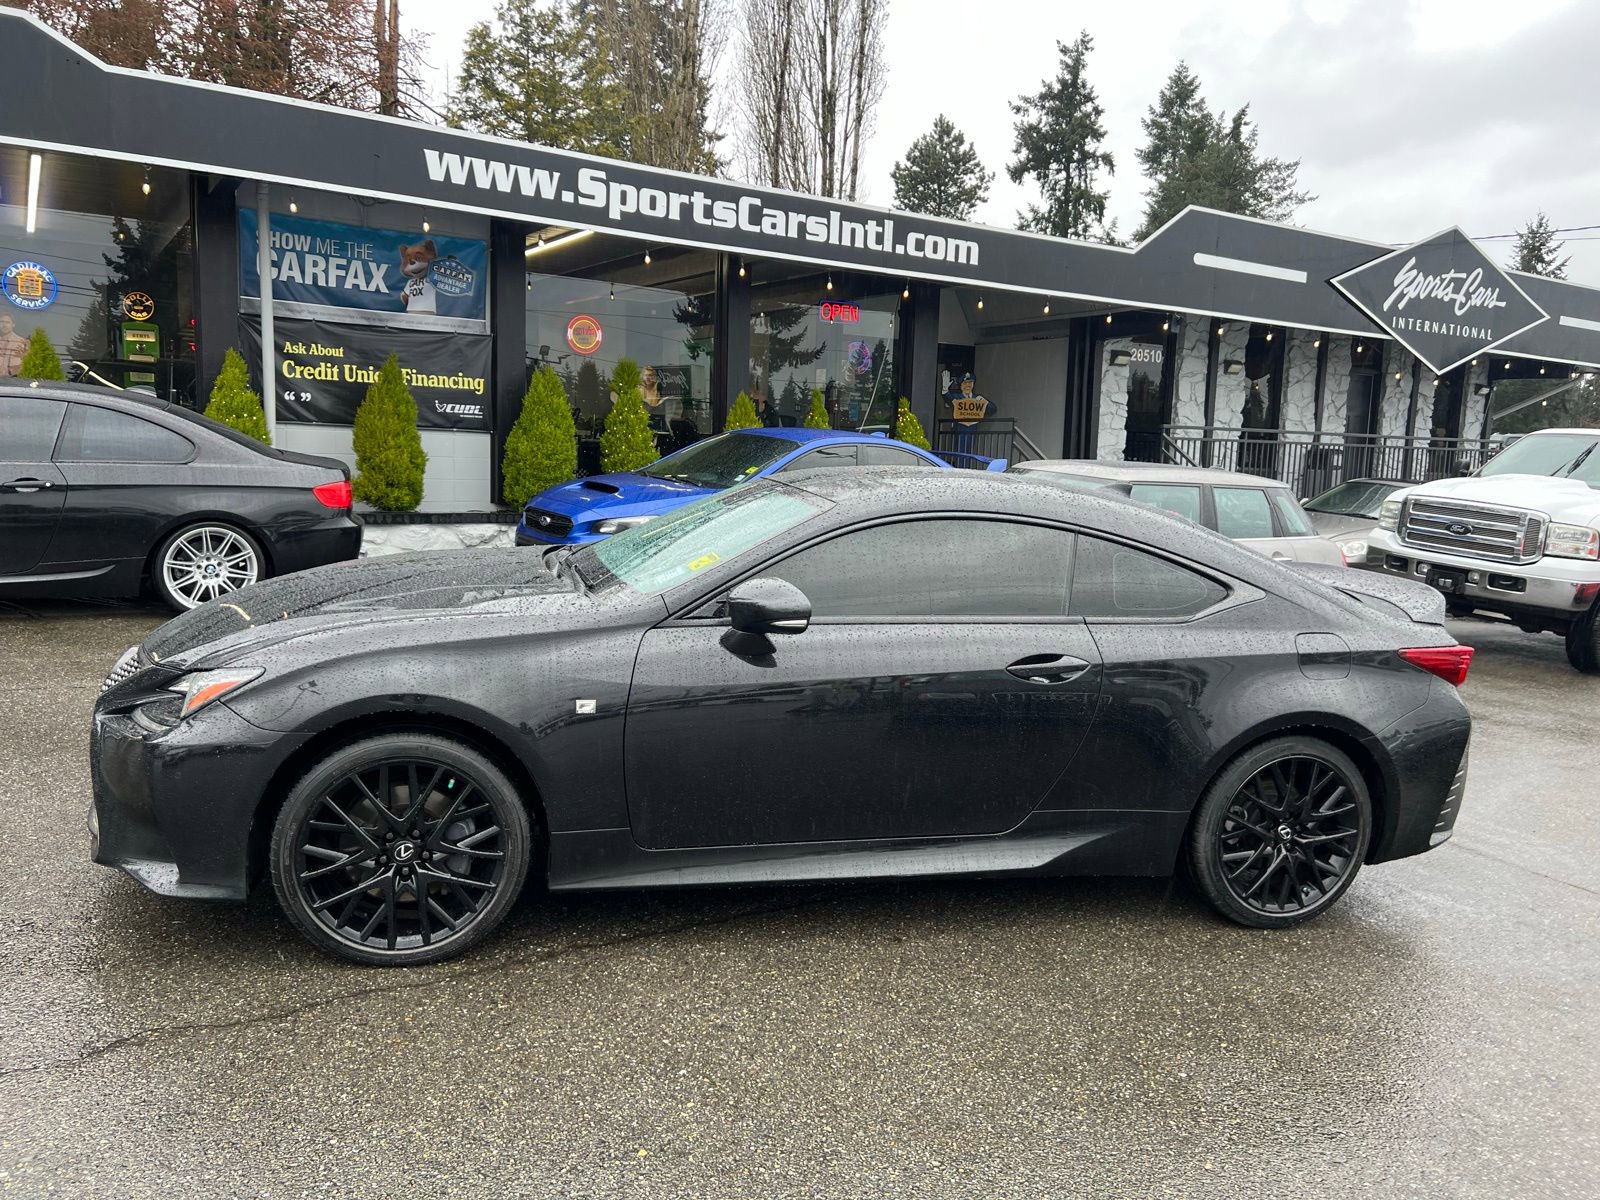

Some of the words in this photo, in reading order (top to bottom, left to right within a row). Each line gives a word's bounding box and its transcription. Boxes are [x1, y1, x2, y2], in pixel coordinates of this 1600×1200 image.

[423, 148, 979, 266] www.SportsCarsIntl.com
[256, 230, 311, 252] HOW
[316, 238, 340, 257] ME
[344, 241, 374, 261] THE
[6, 262, 52, 282] CADILLAC
[433, 265, 472, 282] CARFAX
[409, 278, 425, 288] CAR
[433, 274, 467, 289] ADVANTAGE
[436, 282, 460, 294] DEALER
[409, 286, 424, 297] FOX
[10, 293, 49, 308] SERVICE
[821, 303, 859, 322] OPEN
[1392, 316, 1493, 341] INTERNATIONAL
[284, 342, 306, 354] Ask
[309, 344, 344, 358] About
[1130, 348, 1162, 363] 20510
[282, 360, 339, 381] Credit
[344, 364, 382, 384] Unio
[401, 368, 484, 395] Financing
[958, 401, 984, 412] SLOW
